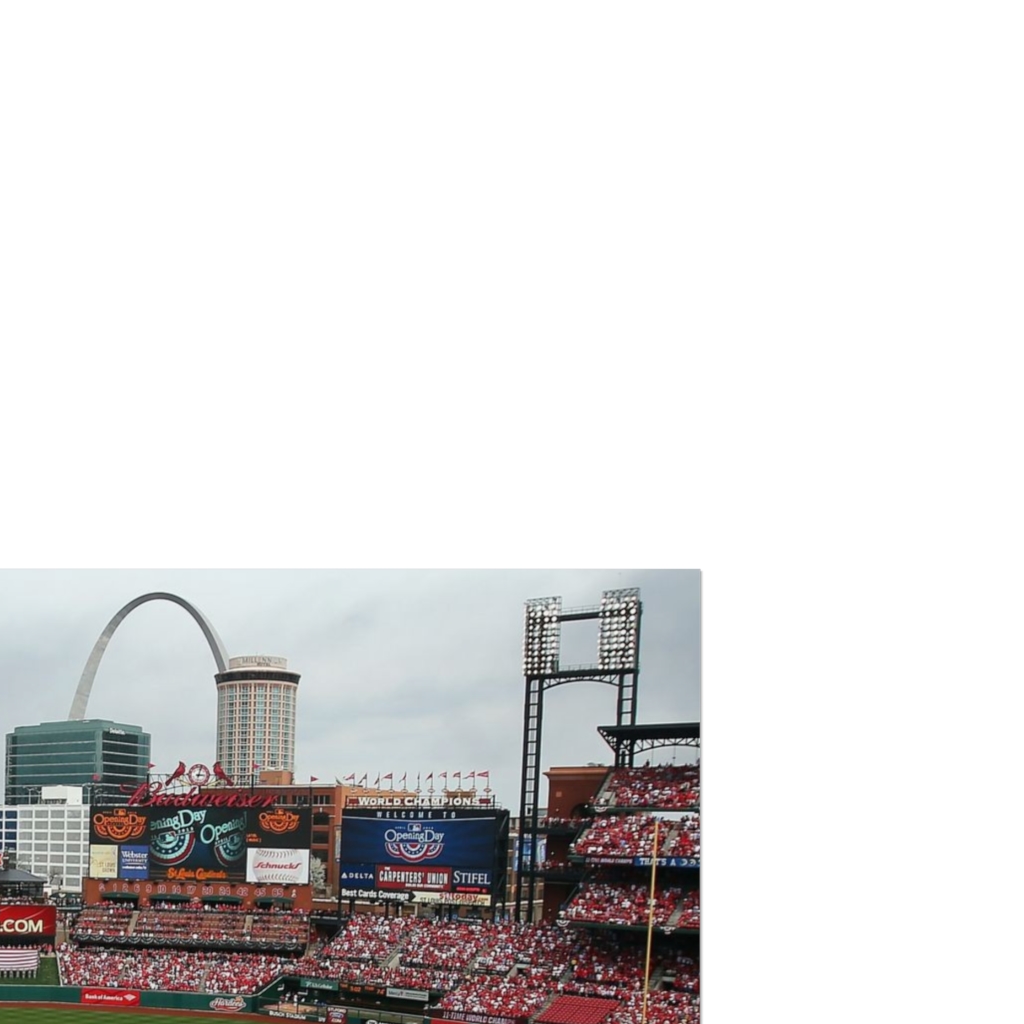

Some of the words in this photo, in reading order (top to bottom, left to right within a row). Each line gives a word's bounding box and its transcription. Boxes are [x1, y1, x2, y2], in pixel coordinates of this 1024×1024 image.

[120, 781, 278, 807] Budweiser
[358, 797, 402, 806] WORLD
[403, 797, 480, 806] CHAMPIONS
[93, 813, 129, 825] Opening
[129, 813, 147, 826] Day
[177, 809, 207, 824] Day
[377, 811, 432, 819] WELCOME
[443, 811, 456, 819] TO
[384, 829, 425, 843] Opening
[424, 829, 445, 843] Day
[121, 851, 147, 859] Webster
[379, 871, 425, 883] CARPENTERS'
[427, 872, 448, 884] UNION
[453, 871, 492, 885] STIFEL
[146, 883, 152, 894] 9
[157, 884, 167, 894] 10
[236, 886, 248, 896] 42
[342, 889, 357, 897] Best
[358, 889, 377, 898] Cards
[378, 890, 409, 900] Coverage
[286, 1012, 306, 1020] STADIUM
[465, 1014, 487, 1024] WORLD
